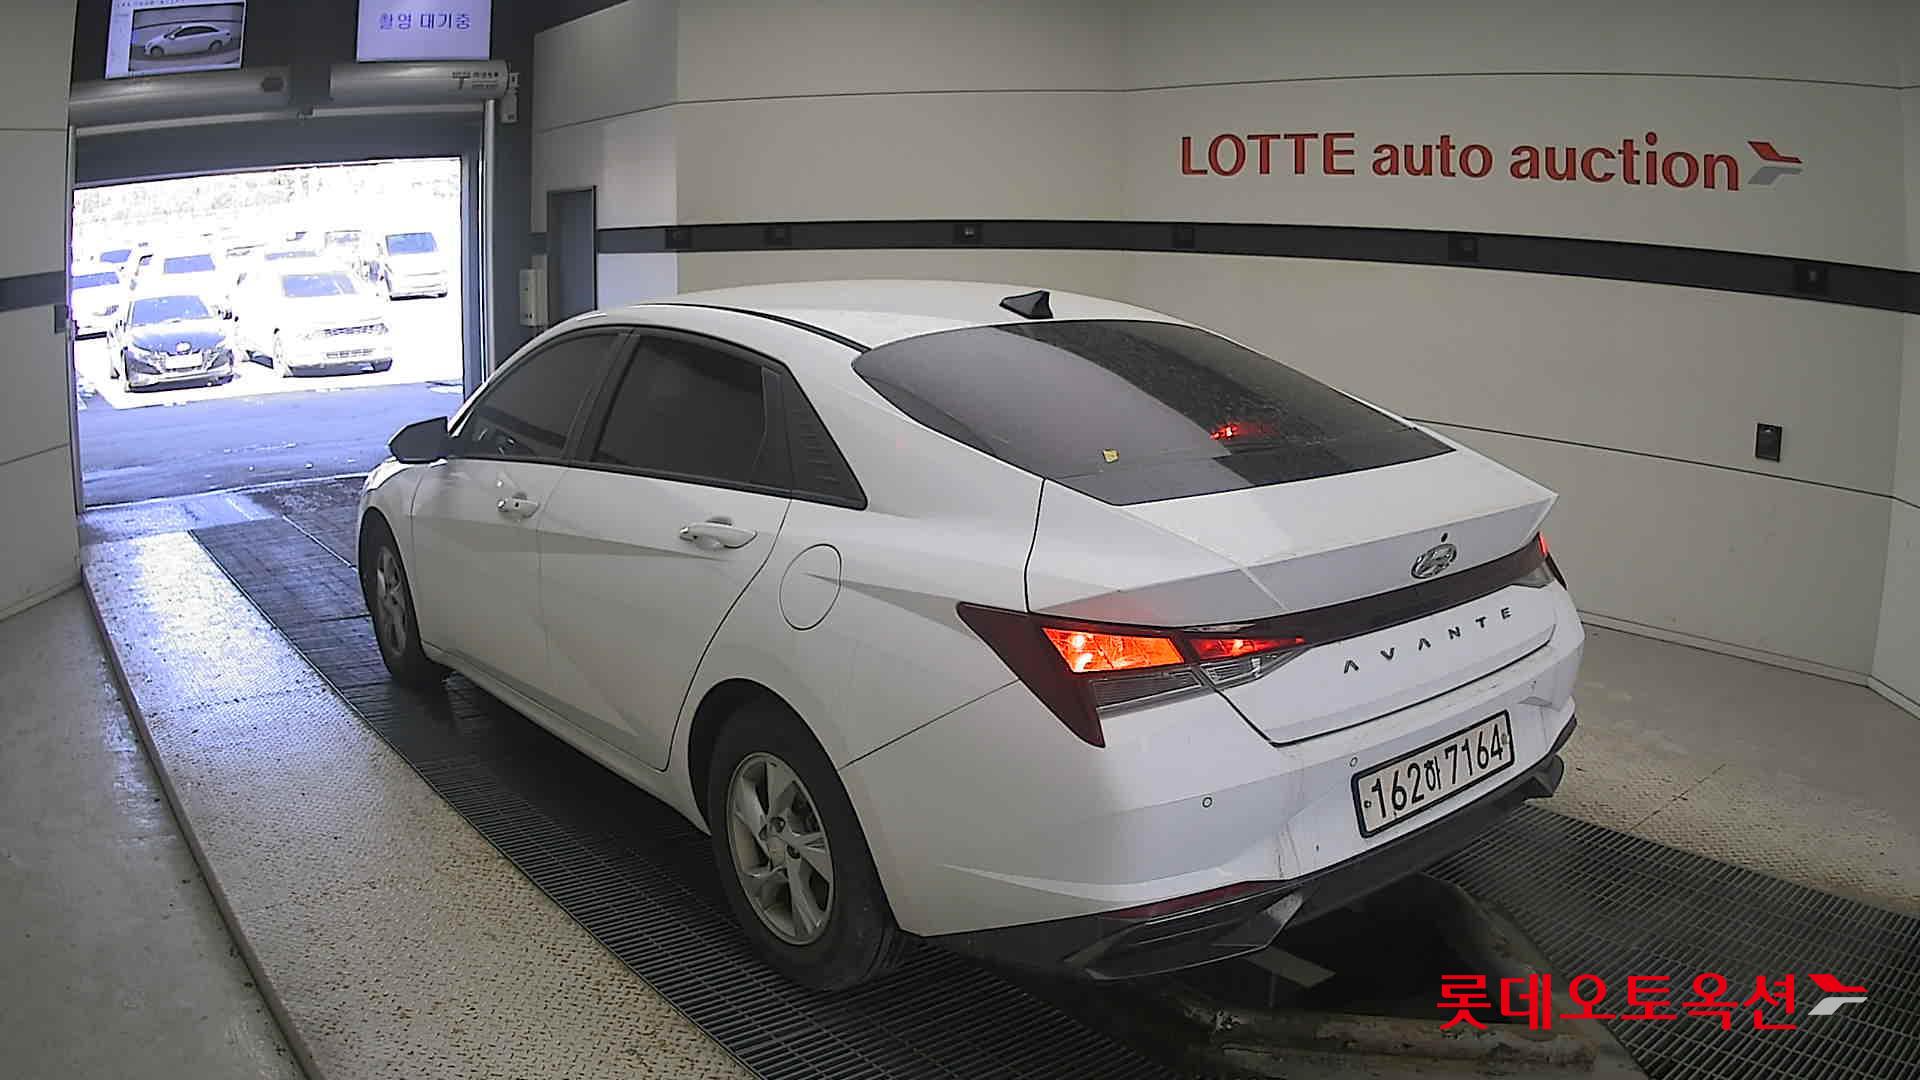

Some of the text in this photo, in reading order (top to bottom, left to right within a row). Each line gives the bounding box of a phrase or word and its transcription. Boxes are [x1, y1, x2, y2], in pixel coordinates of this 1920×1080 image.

[420, 13, 471, 30] 대기중
[1182, 132, 1740, 190] LOTTE auto auction
[1343, 607, 1513, 675] AVANTE
